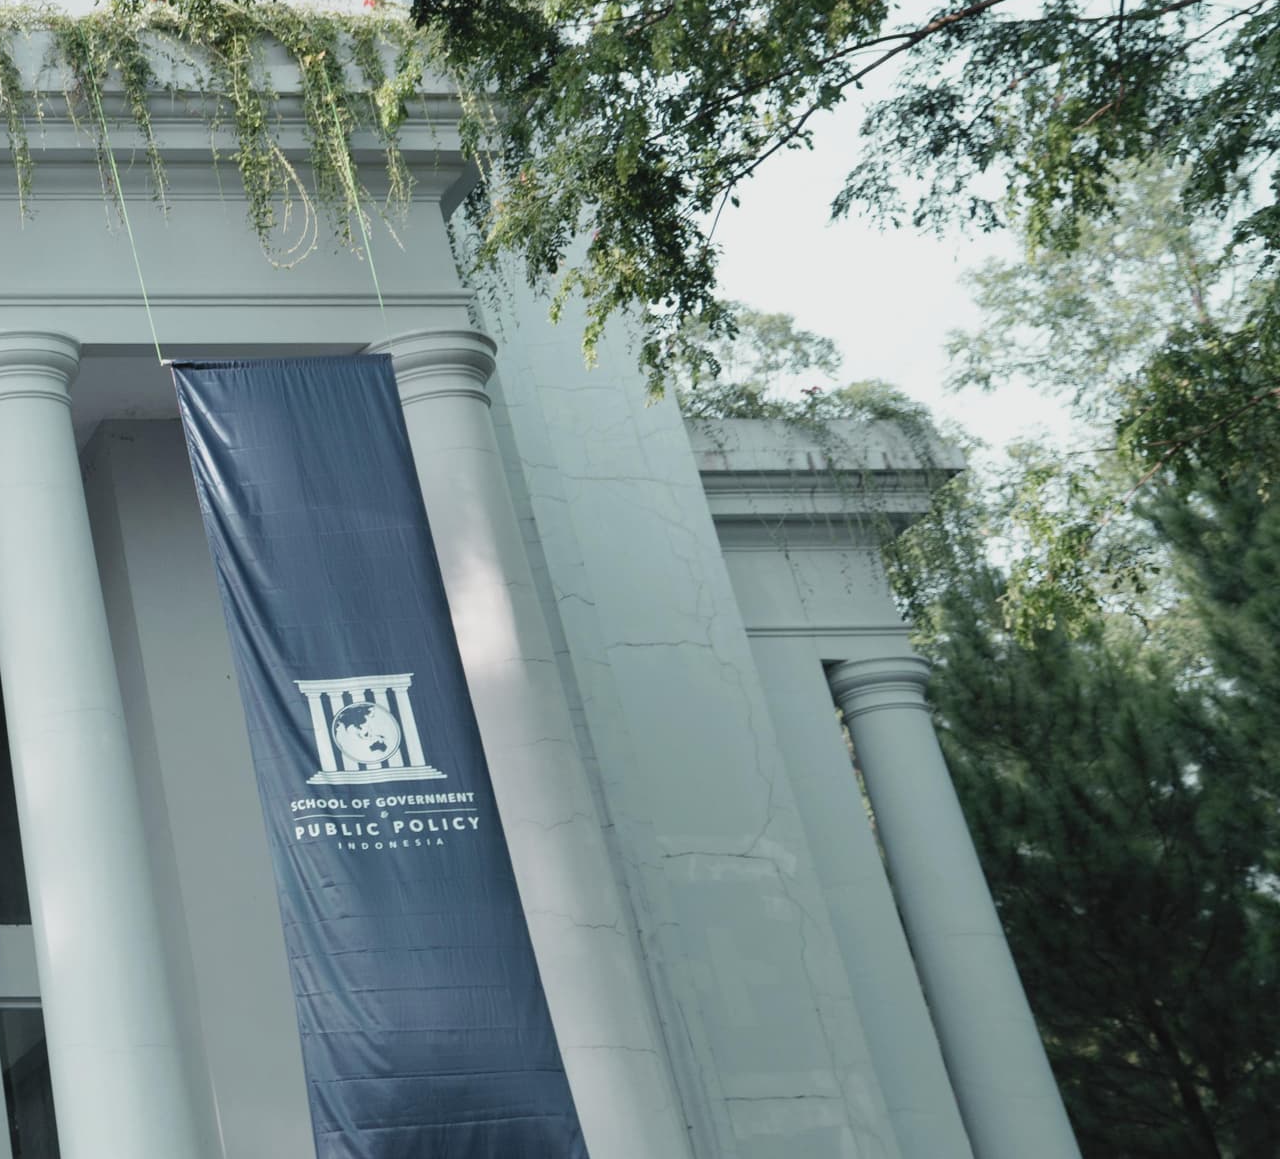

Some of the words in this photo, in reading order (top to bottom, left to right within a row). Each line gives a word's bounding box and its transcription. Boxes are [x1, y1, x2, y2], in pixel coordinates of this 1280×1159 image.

[290, 798, 348, 812] SCHOOL
[351, 798, 370, 809] OF
[375, 792, 475, 808] GOVERNMENT
[380, 810, 389, 819] &
[295, 822, 380, 840] PUBLIC
[393, 816, 480, 834] POLICY
[338, 838, 444, 850] INDONESIA
